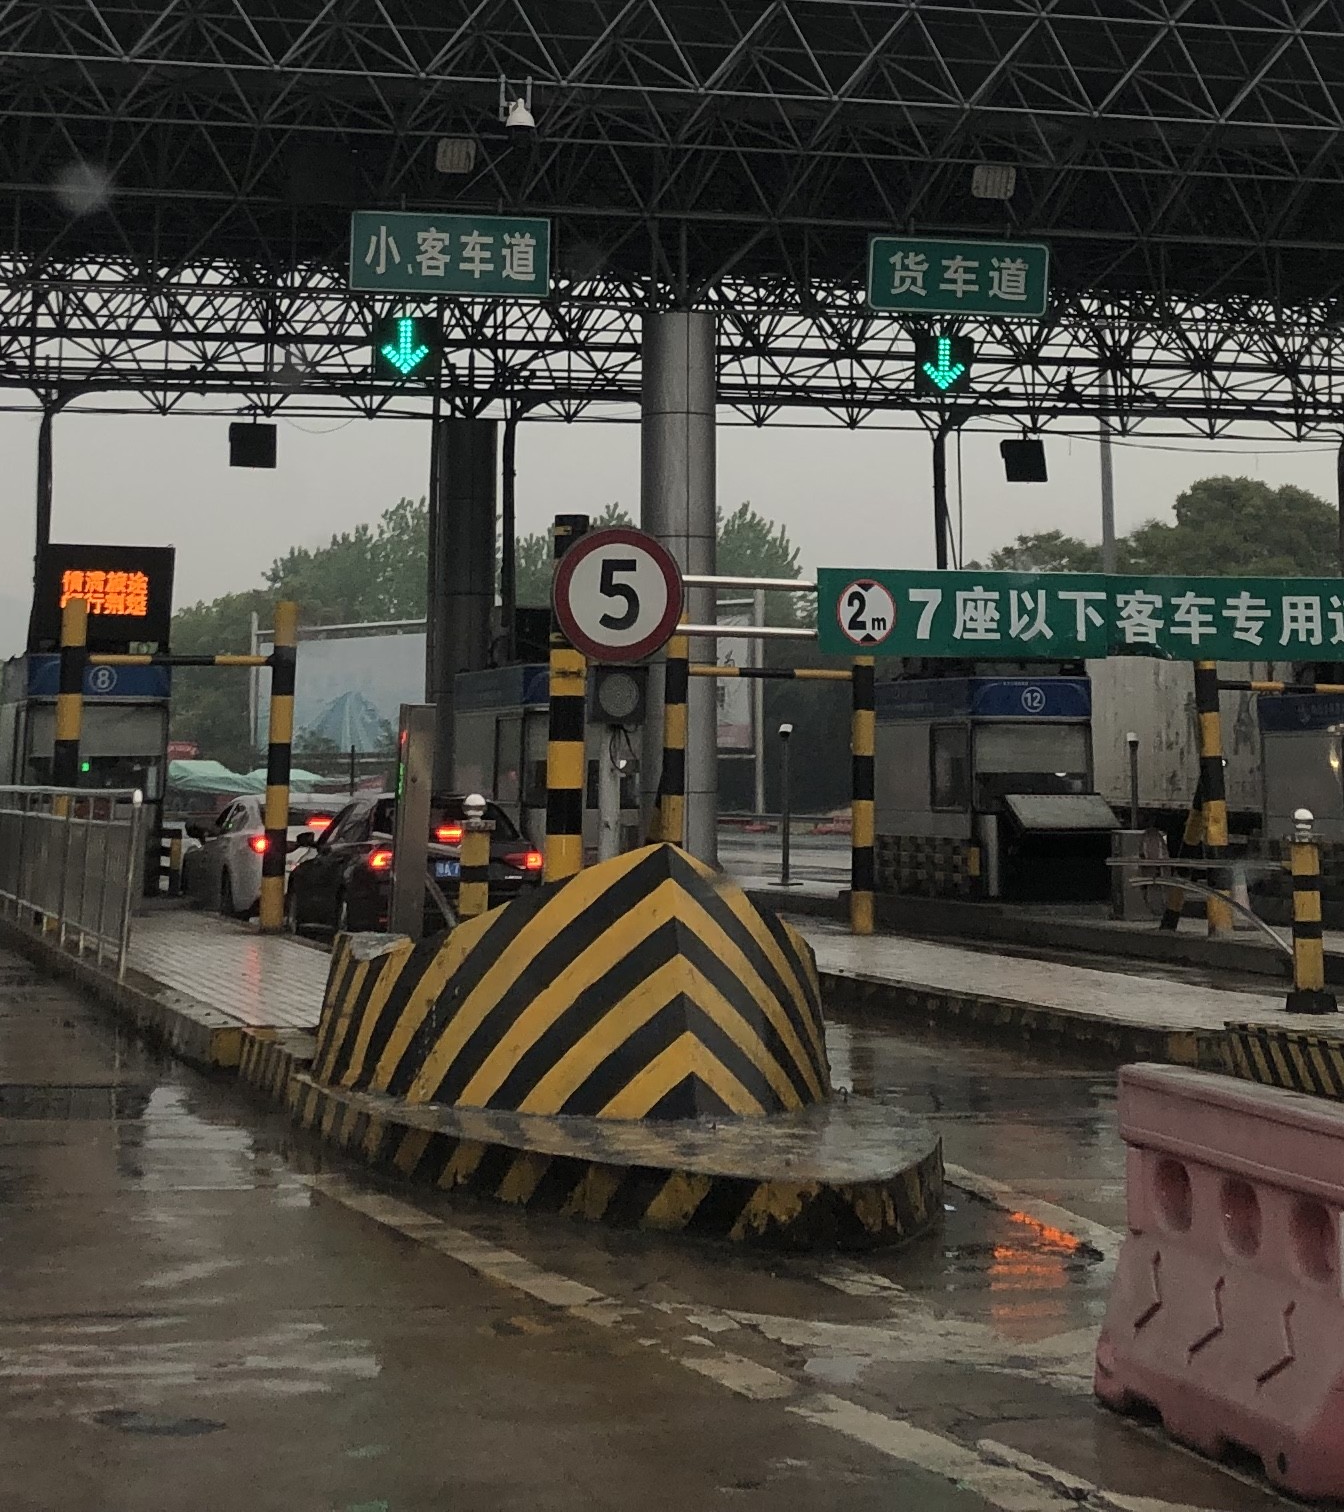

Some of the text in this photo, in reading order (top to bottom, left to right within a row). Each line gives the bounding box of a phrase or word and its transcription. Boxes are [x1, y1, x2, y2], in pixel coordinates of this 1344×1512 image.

[364, 225, 538, 281] 小客车道
[888, 251, 1029, 301] 货车道
[599, 559, 640, 630] 5
[95, 670, 111, 689] 8
[1025, 693, 1042, 707] 12
